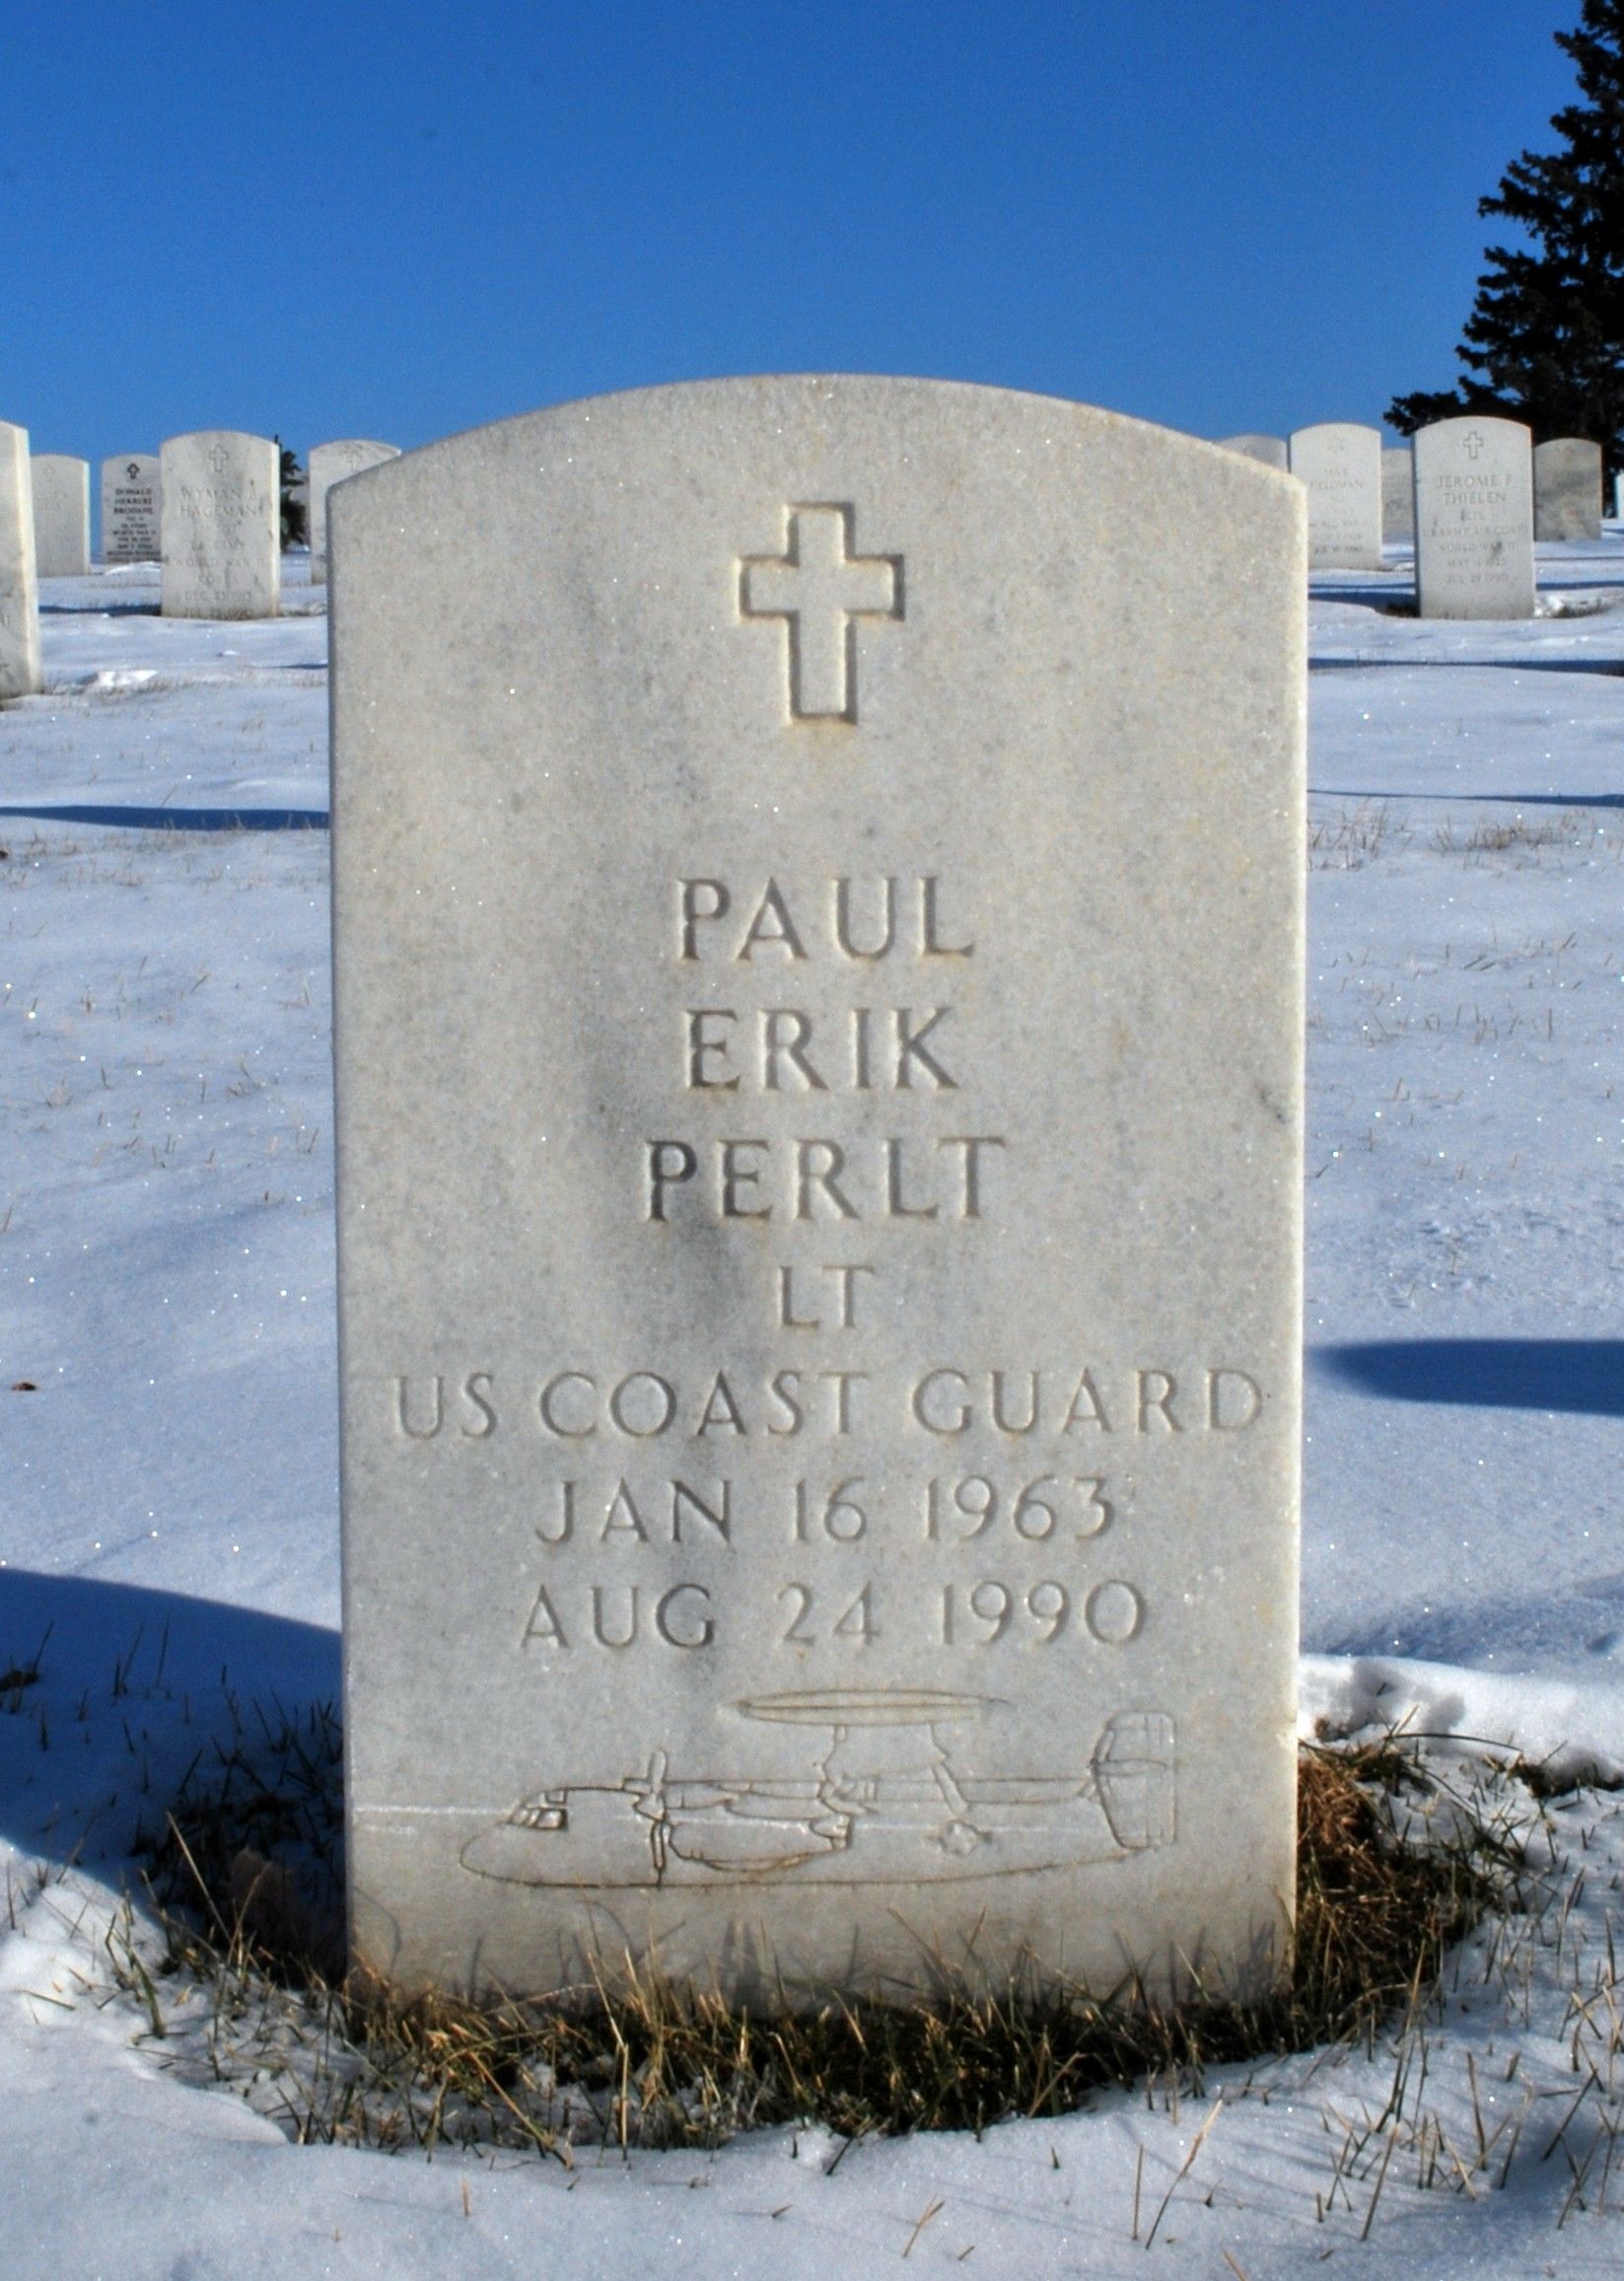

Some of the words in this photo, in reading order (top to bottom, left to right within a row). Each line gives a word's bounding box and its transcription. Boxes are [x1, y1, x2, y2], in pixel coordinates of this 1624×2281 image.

[179, 486, 242, 499] WYMAN
[179, 504, 256, 517] HAGEMAN
[1437, 474, 1498, 488] JEROME
[1444, 492, 1507, 505] THIELEN
[677, 874, 975, 962] PAUL
[685, 1006, 962, 1091] ERIK
[646, 1136, 1008, 1221] PERLT
[778, 1264, 876, 1329] LT
[397, 1373, 497, 1440] US
[539, 1371, 869, 1439] COAST
[913, 1367, 1264, 1437] GUARD
[535, 1478, 732, 1545] JAN
[794, 1477, 870, 1543] 16
[928, 1476, 1116, 1543] 1963
[521, 1583, 718, 1650] AUG
[779, 1581, 876, 1647] 24
[944, 1580, 1149, 1647] 1990
